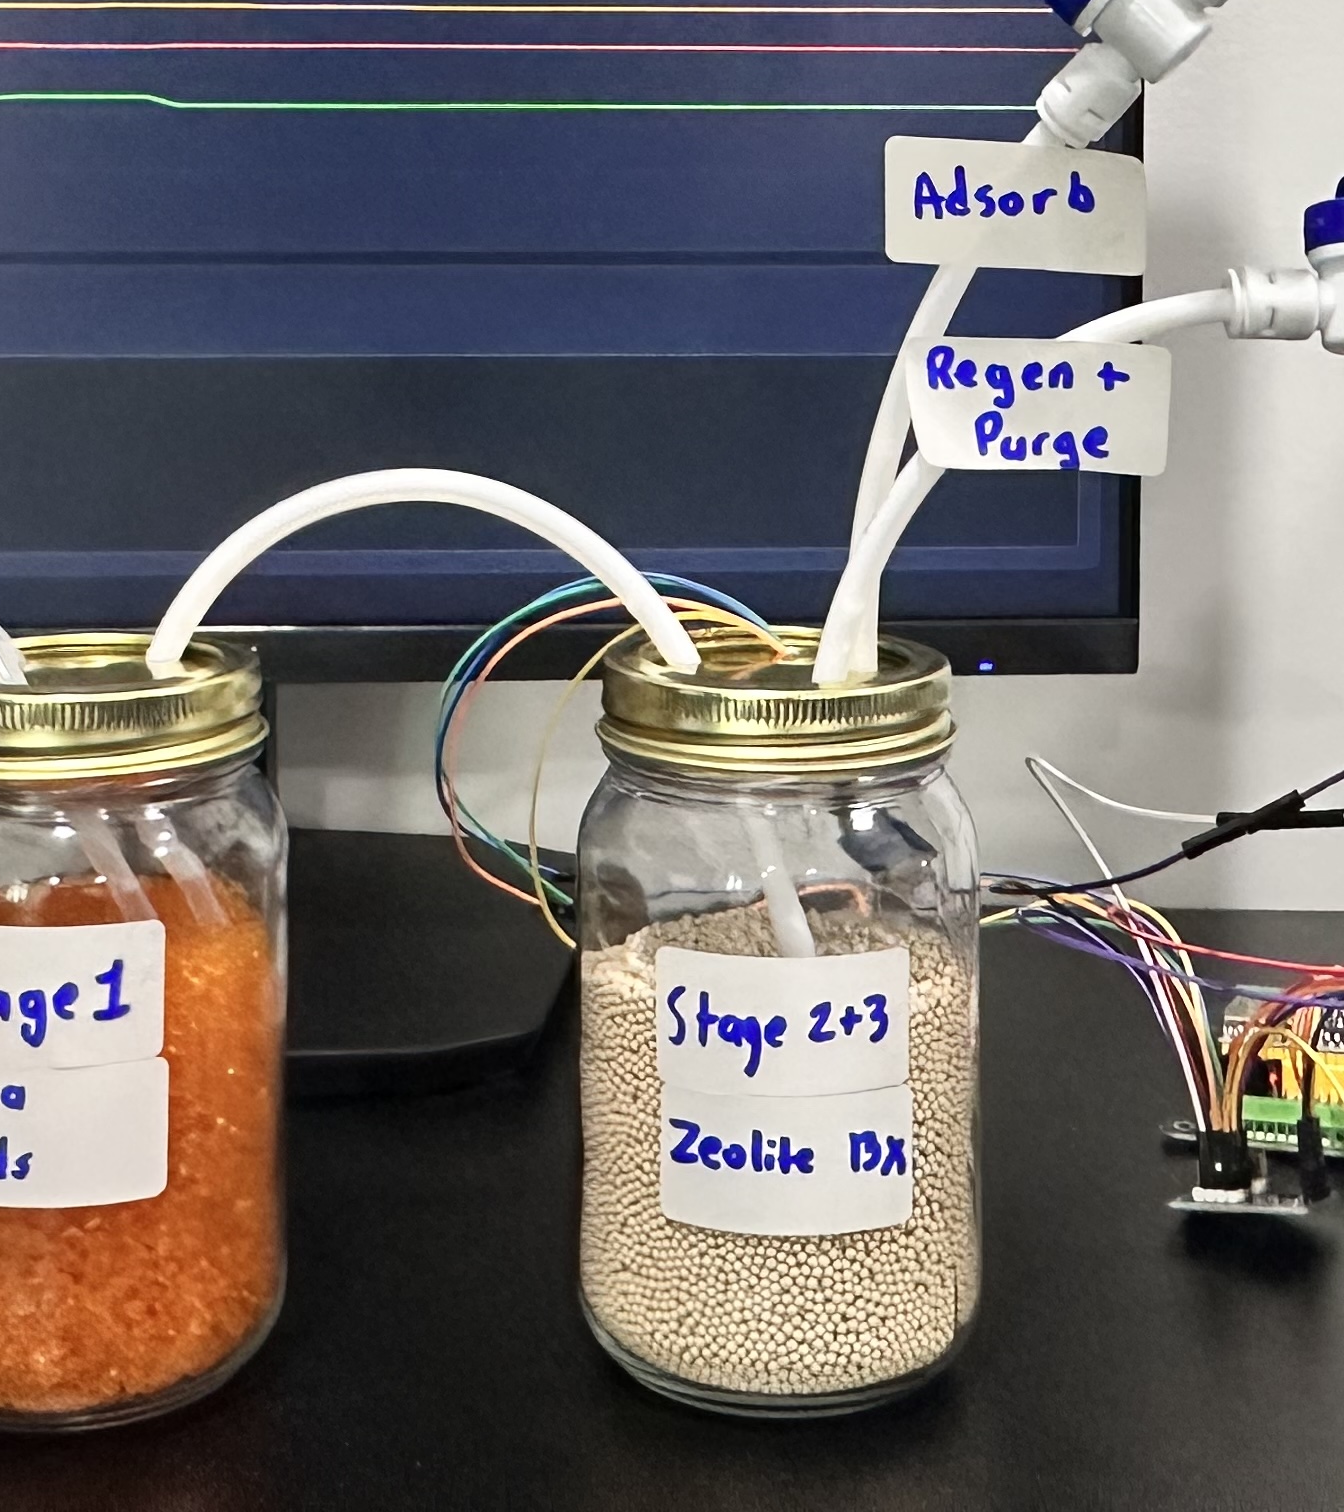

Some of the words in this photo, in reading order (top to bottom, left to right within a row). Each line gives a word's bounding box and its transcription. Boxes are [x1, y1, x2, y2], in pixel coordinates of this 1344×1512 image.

[913, 164, 1096, 220] Adsorb
[926, 345, 1075, 409] Regen
[1096, 360, 1131, 392] +
[974, 410, 1110, 471] Purge
[92, 959, 131, 1022] 1
[666, 985, 788, 1078] Stage
[668, 1117, 815, 1175] Zeolite
